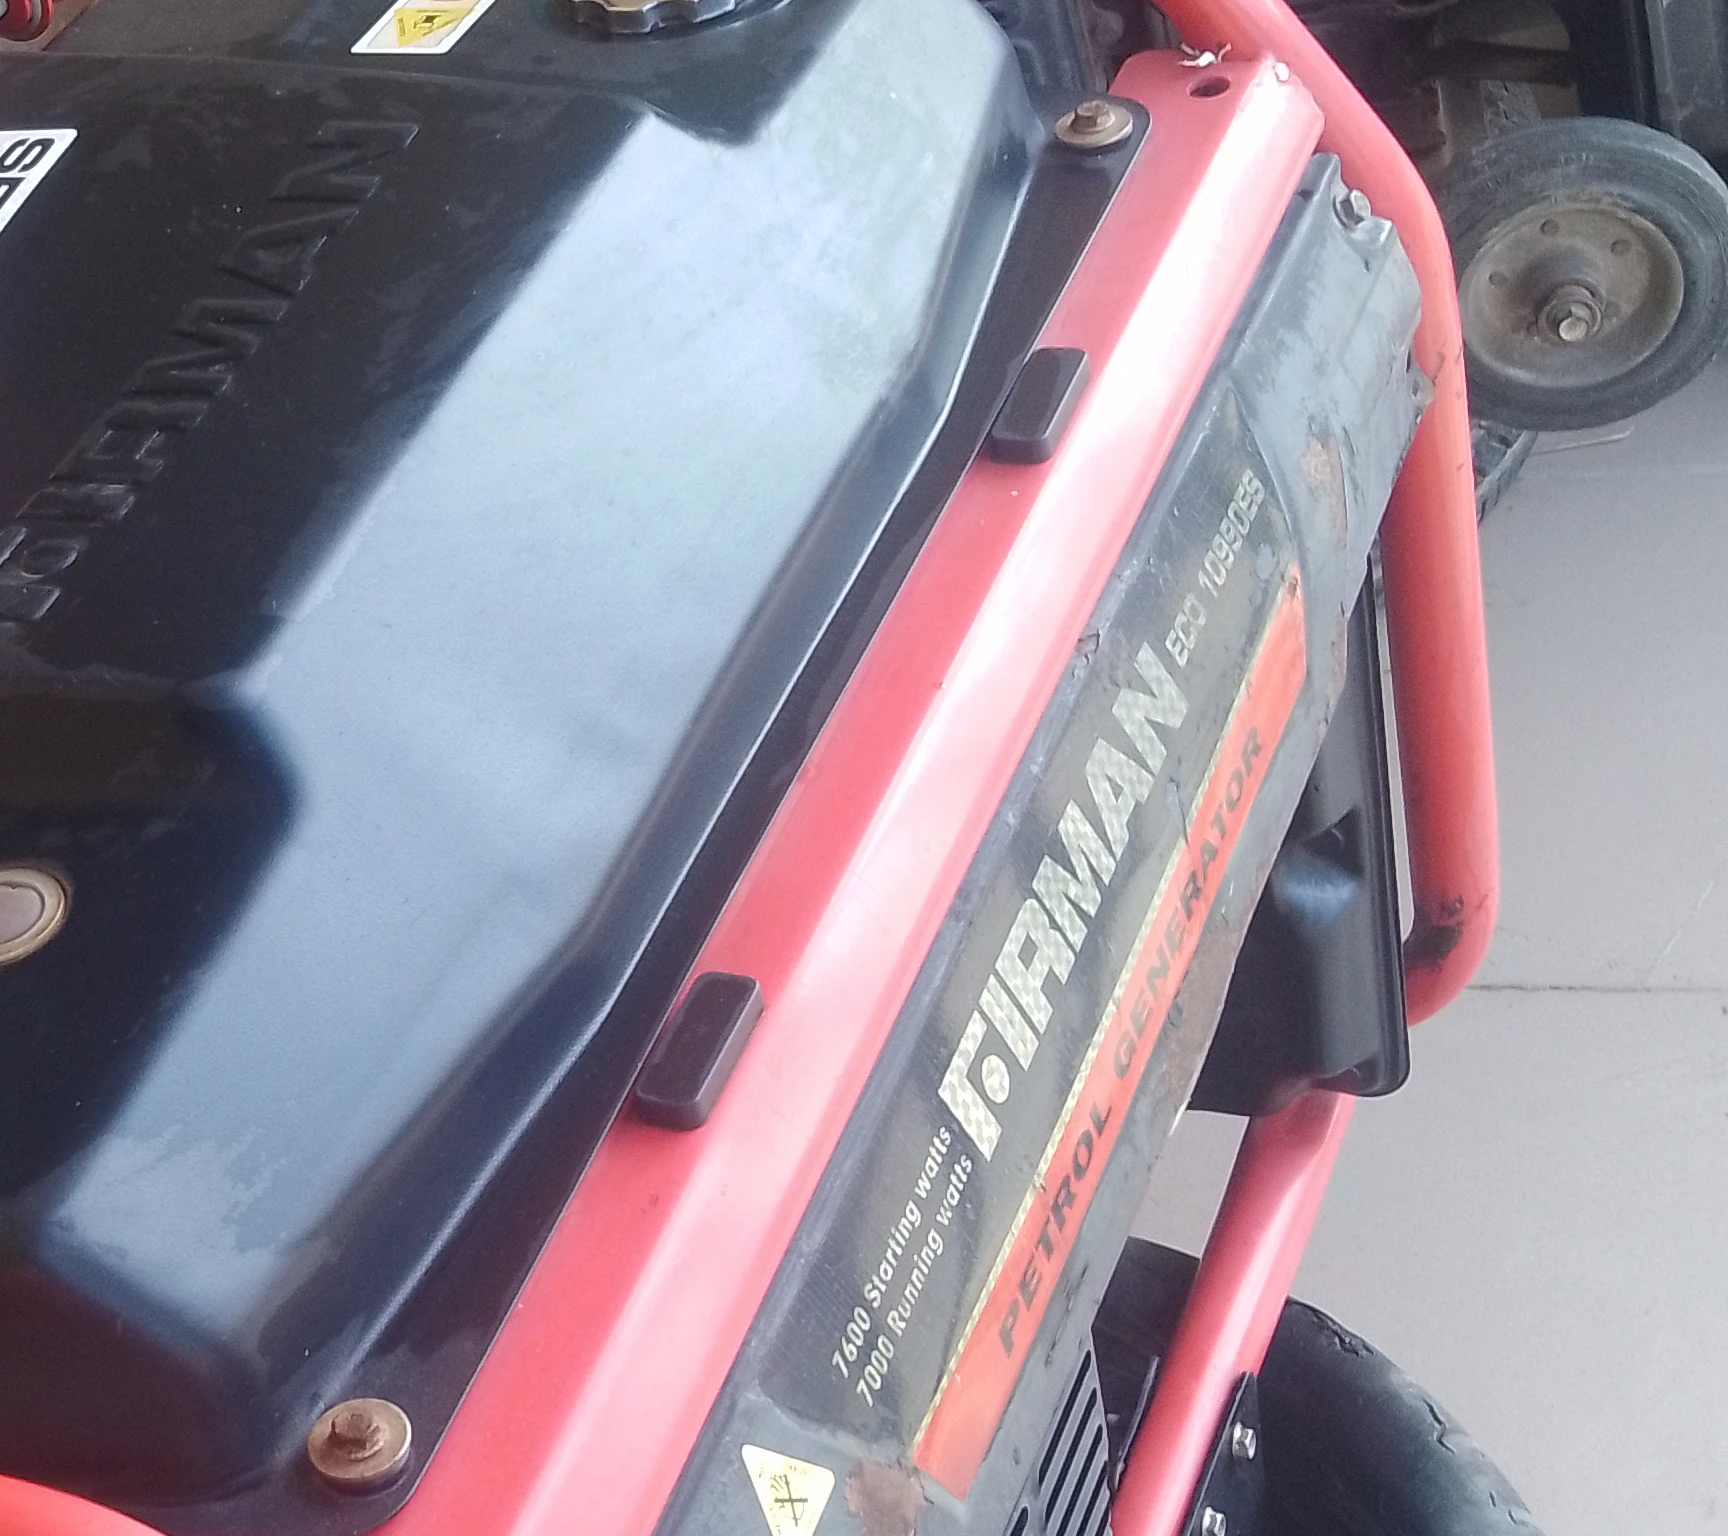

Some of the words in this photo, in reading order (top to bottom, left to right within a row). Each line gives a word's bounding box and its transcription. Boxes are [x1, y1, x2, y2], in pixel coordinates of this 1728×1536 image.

[1164, 592, 1207, 668] ECO
[1198, 468, 1266, 598] 10990ES
[937, 641, 1190, 1162] FIRMAN
[999, 1102, 1112, 1357] PETROL
[1112, 726, 1264, 1080] GENERATOR
[831, 1305, 872, 1379] 7600
[864, 1199, 922, 1309] Starting
[914, 1126, 952, 1199] watts
[856, 1334, 895, 1407] 7000
[886, 1227, 945, 1337] Running
[936, 1154, 973, 1227] watts
